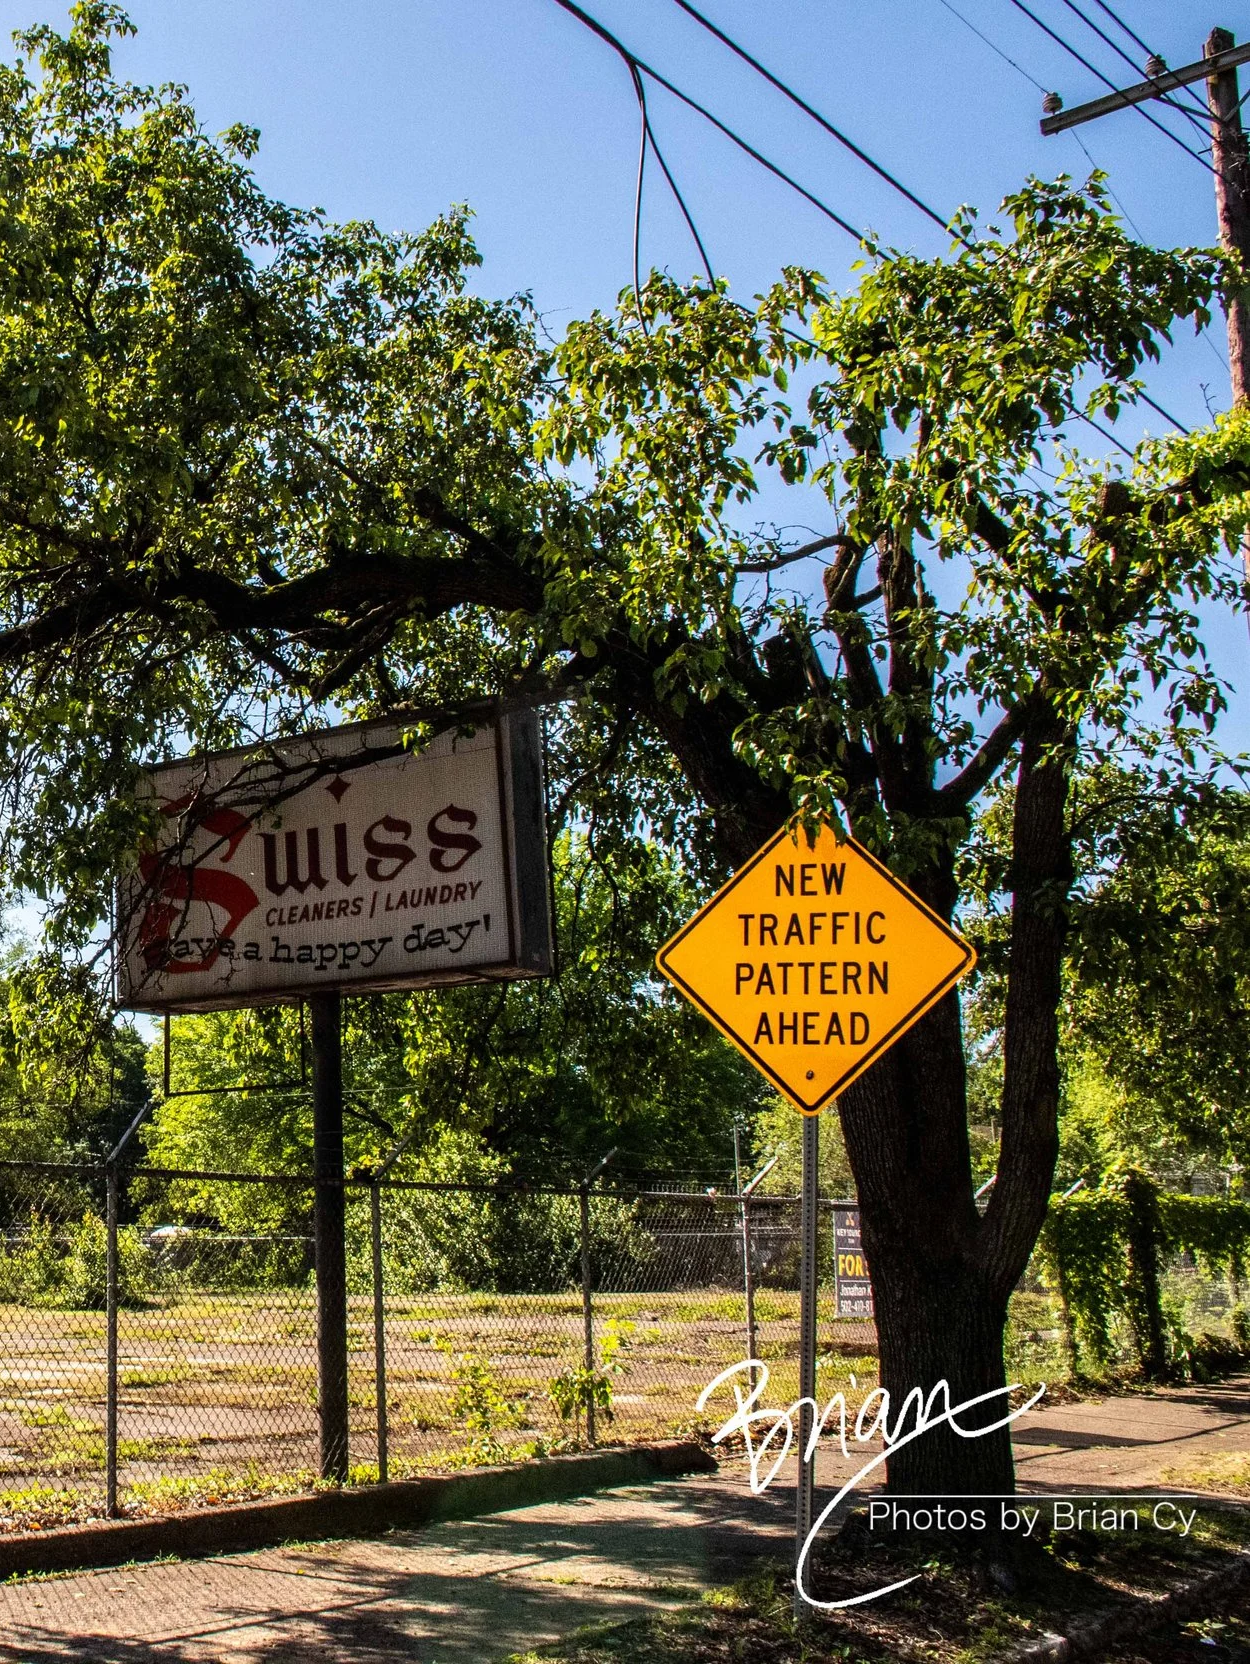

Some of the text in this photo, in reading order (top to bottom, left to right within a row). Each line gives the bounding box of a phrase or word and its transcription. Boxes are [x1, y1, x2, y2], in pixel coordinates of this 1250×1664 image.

[138, 776, 483, 974] Swiss
[775, 862, 847, 897] NEW
[265, 896, 364, 927] CLEANERS
[384, 880, 483, 912] LAUNDRY
[737, 911, 886, 946] TRAFFIC
[152, 936, 237, 964] ave
[243, 941, 263, 961] a
[269, 935, 393, 971] happy
[735, 961, 889, 996] PATTERN
[753, 1011, 870, 1046] AHEAD
[838, 1254, 864, 1277] FOR
